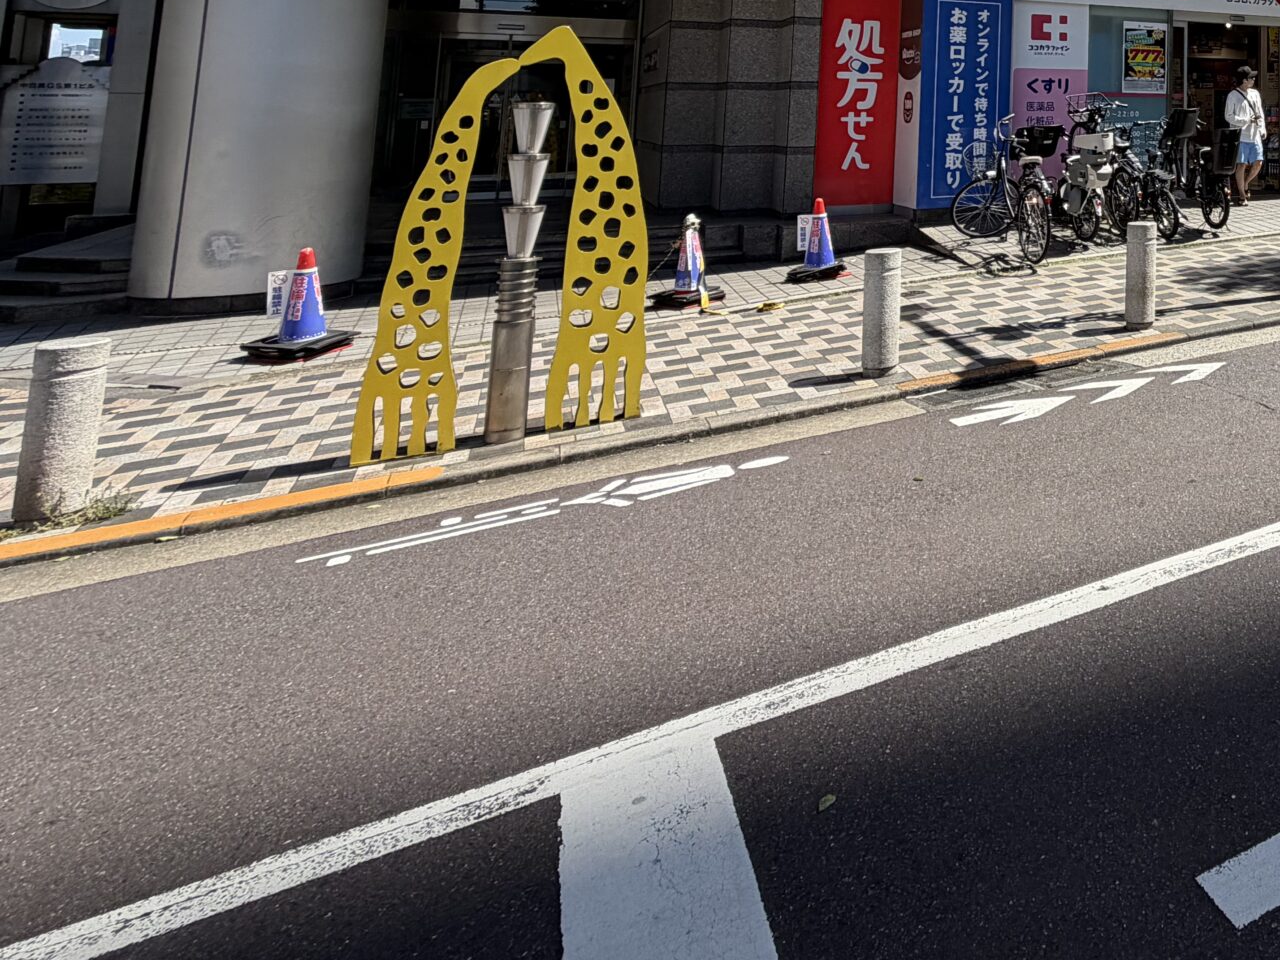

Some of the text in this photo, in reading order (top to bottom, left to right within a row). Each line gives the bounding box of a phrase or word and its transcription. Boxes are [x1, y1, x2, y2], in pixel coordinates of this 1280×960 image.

[835, 18, 885, 170] 処方せん
[943, 7, 968, 189] お薬ロッカーで受取り
[971, 8, 991, 186] オンラインで待ち時間短
[1026, 78, 1070, 94] くすり
[1026, 101, 1055, 112] 医薬品
